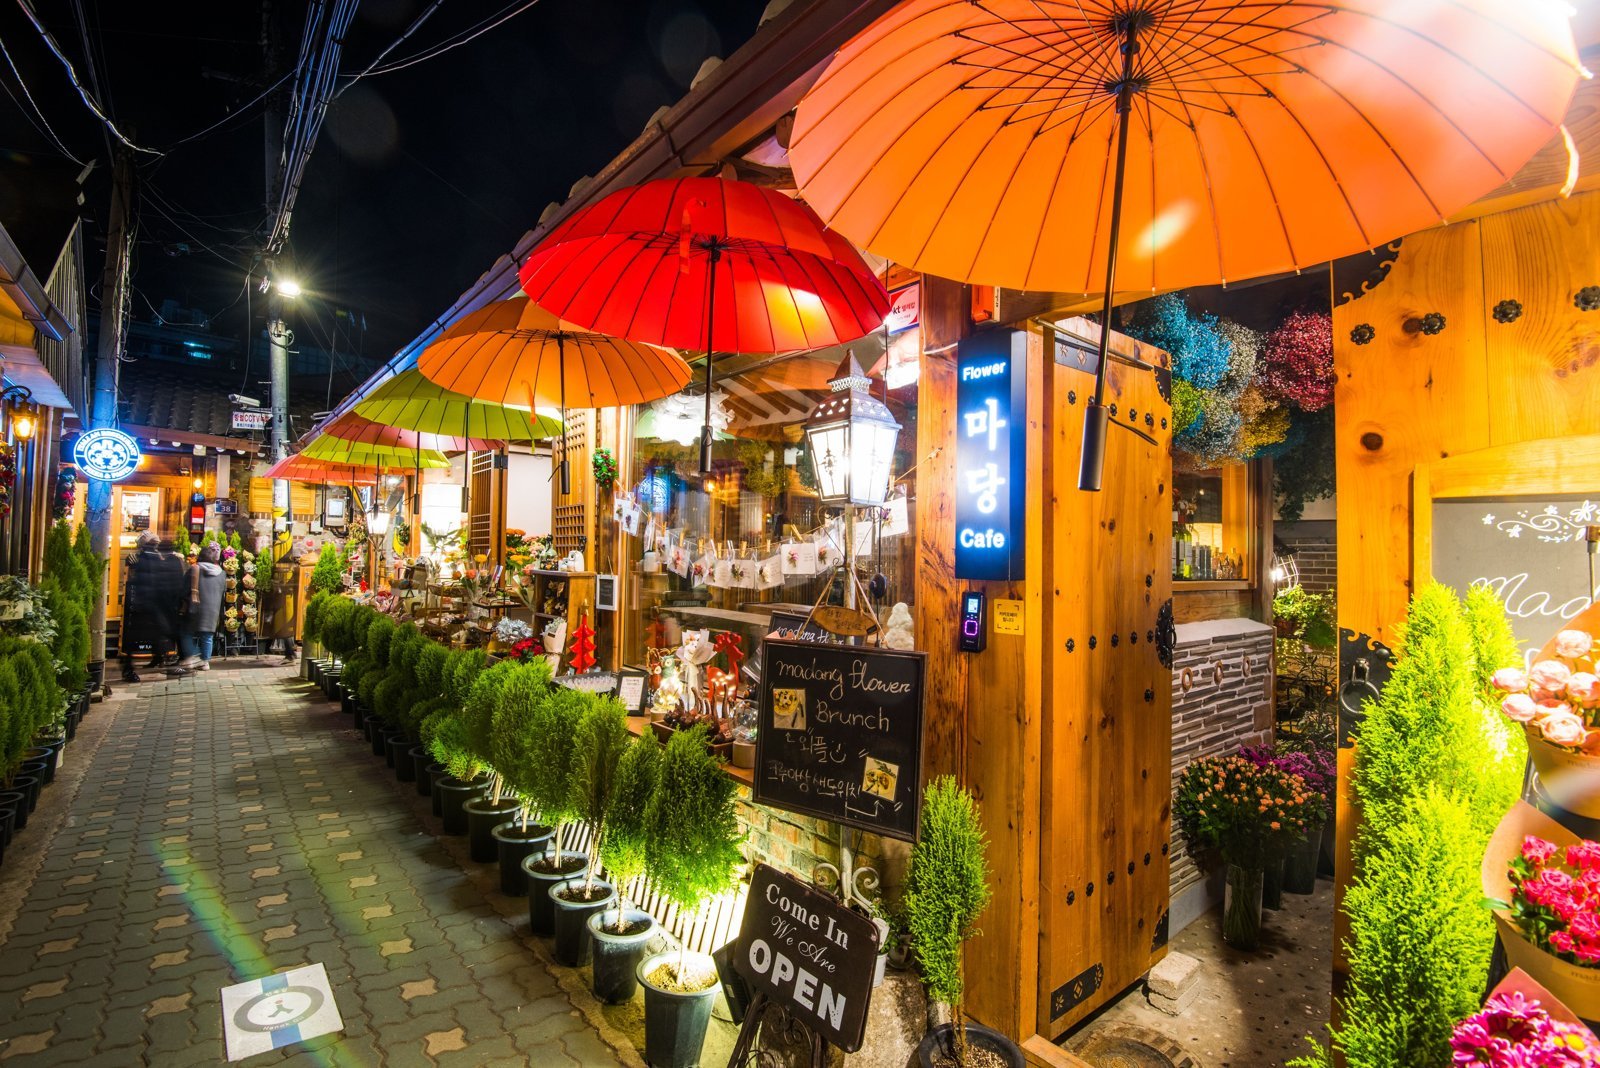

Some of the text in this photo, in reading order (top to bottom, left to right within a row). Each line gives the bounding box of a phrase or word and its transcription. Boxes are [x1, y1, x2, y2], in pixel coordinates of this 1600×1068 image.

[893, 305, 901, 315] kt
[963, 361, 1007, 381] Flower
[964, 398, 1007, 514] 마당
[221, 505, 231, 513] 38
[960, 528, 1005, 549] Cafe
[776, 657, 911, 700] madang flower
[816, 699, 890, 732] Brunch
[799, 735, 827, 762] 와플
[766, 883, 849, 950] Come In
[771, 915, 836, 973] We Are
[749, 938, 847, 1031] OPEN
